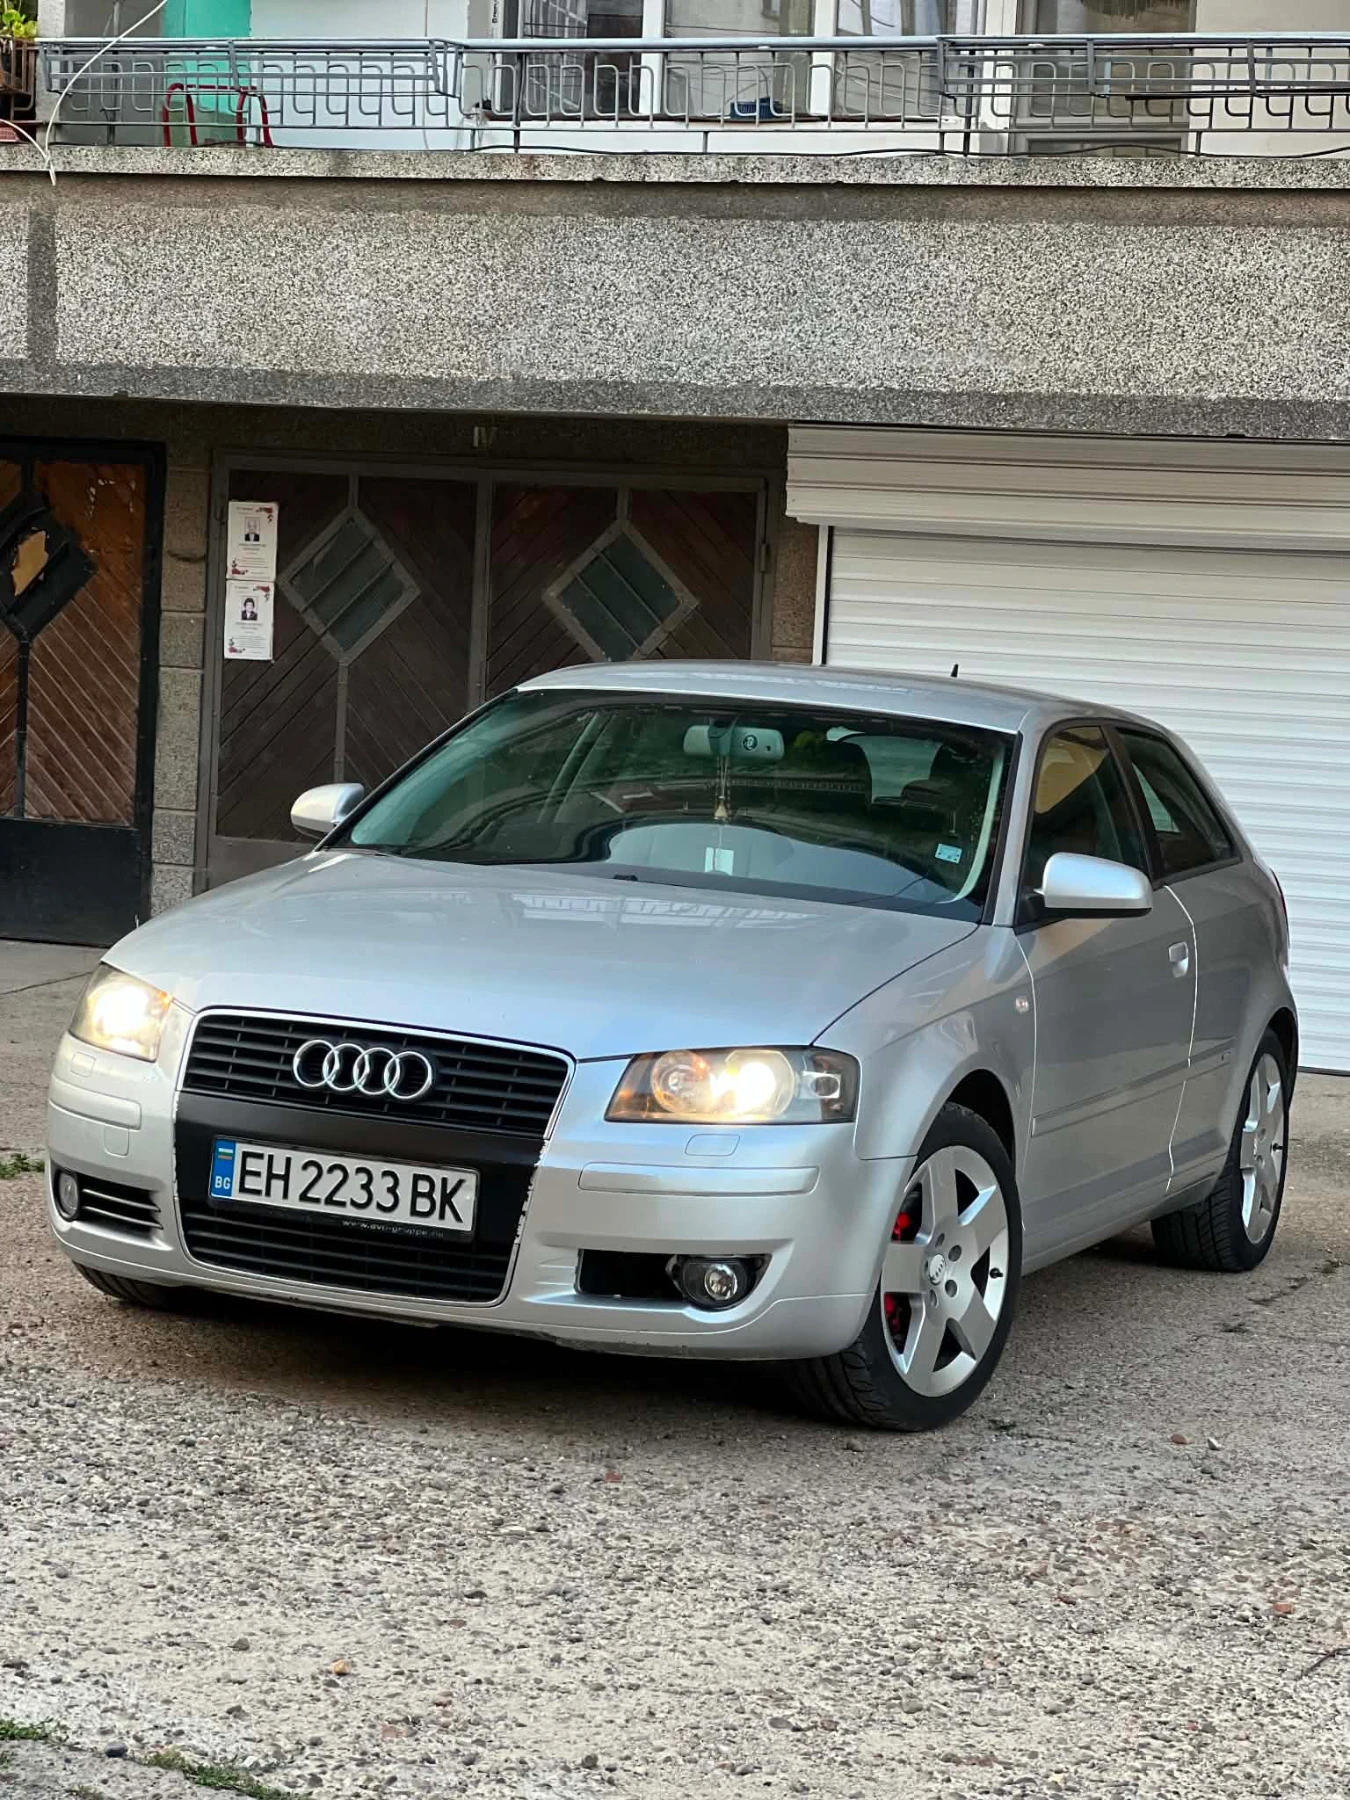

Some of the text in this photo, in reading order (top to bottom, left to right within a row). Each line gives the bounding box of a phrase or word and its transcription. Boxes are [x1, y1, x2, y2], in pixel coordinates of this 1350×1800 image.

[214, 1175, 231, 1190] BG
[239, 1150, 466, 1223] EH 2233 BK
